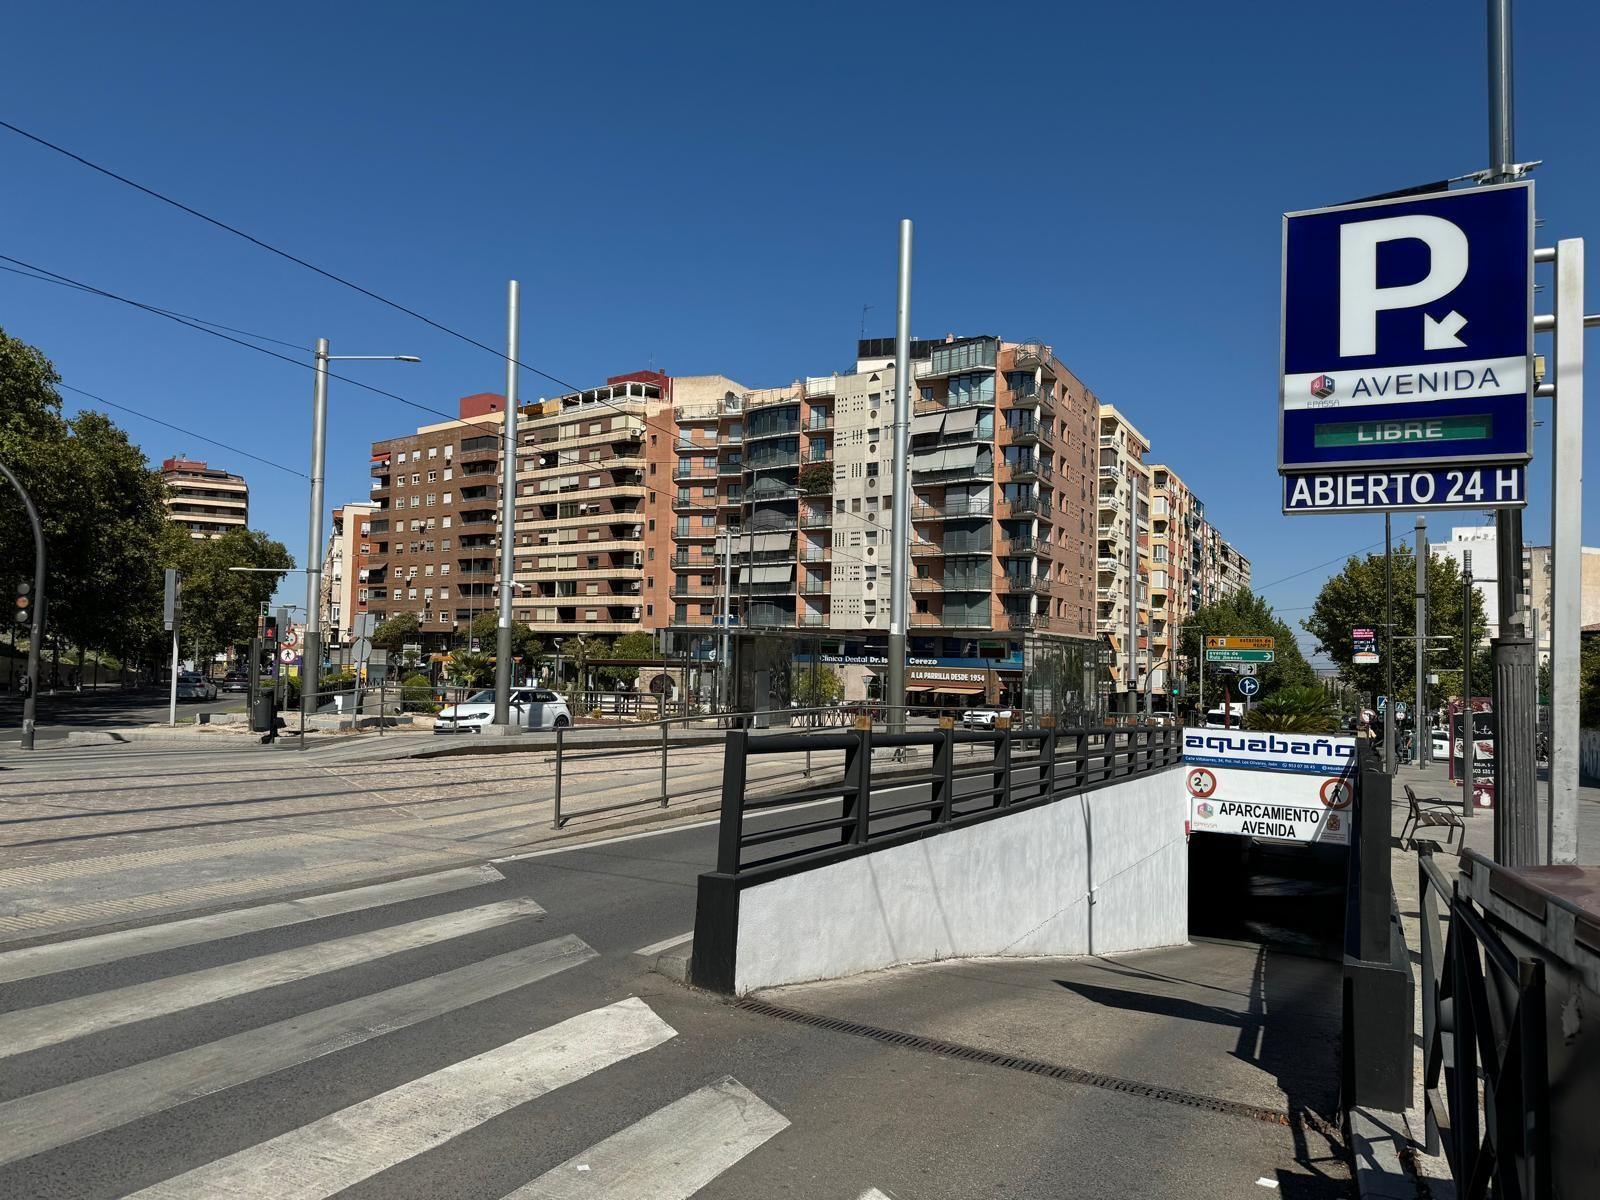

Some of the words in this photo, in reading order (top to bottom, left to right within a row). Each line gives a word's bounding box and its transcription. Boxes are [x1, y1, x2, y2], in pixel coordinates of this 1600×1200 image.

[1339, 214, 1469, 358] P
[1351, 367, 1501, 399] AVENIDA
[1306, 399, 1340, 409] EPASSA
[1357, 420, 1444, 442] LIBRE
[1290, 470, 1435, 507] ABIERTO
[1445, 467, 1484, 503] 24
[1495, 465, 1518, 501] H
[844, 655, 868, 663] Dental
[909, 657, 938, 666] Cerezo
[910, 672, 916, 680] A
[916, 672, 923, 680] LA
[923, 672, 950, 681] PARRILLA
[950, 673, 969, 682] DESDE
[969, 674, 985, 683] 1954
[1185, 734, 1356, 758] aquabaño
[1194, 777, 1202, 787] 2
[1219, 802, 1320, 824] APARCAMIENTO
[1241, 820, 1296, 838] AVENIDA
